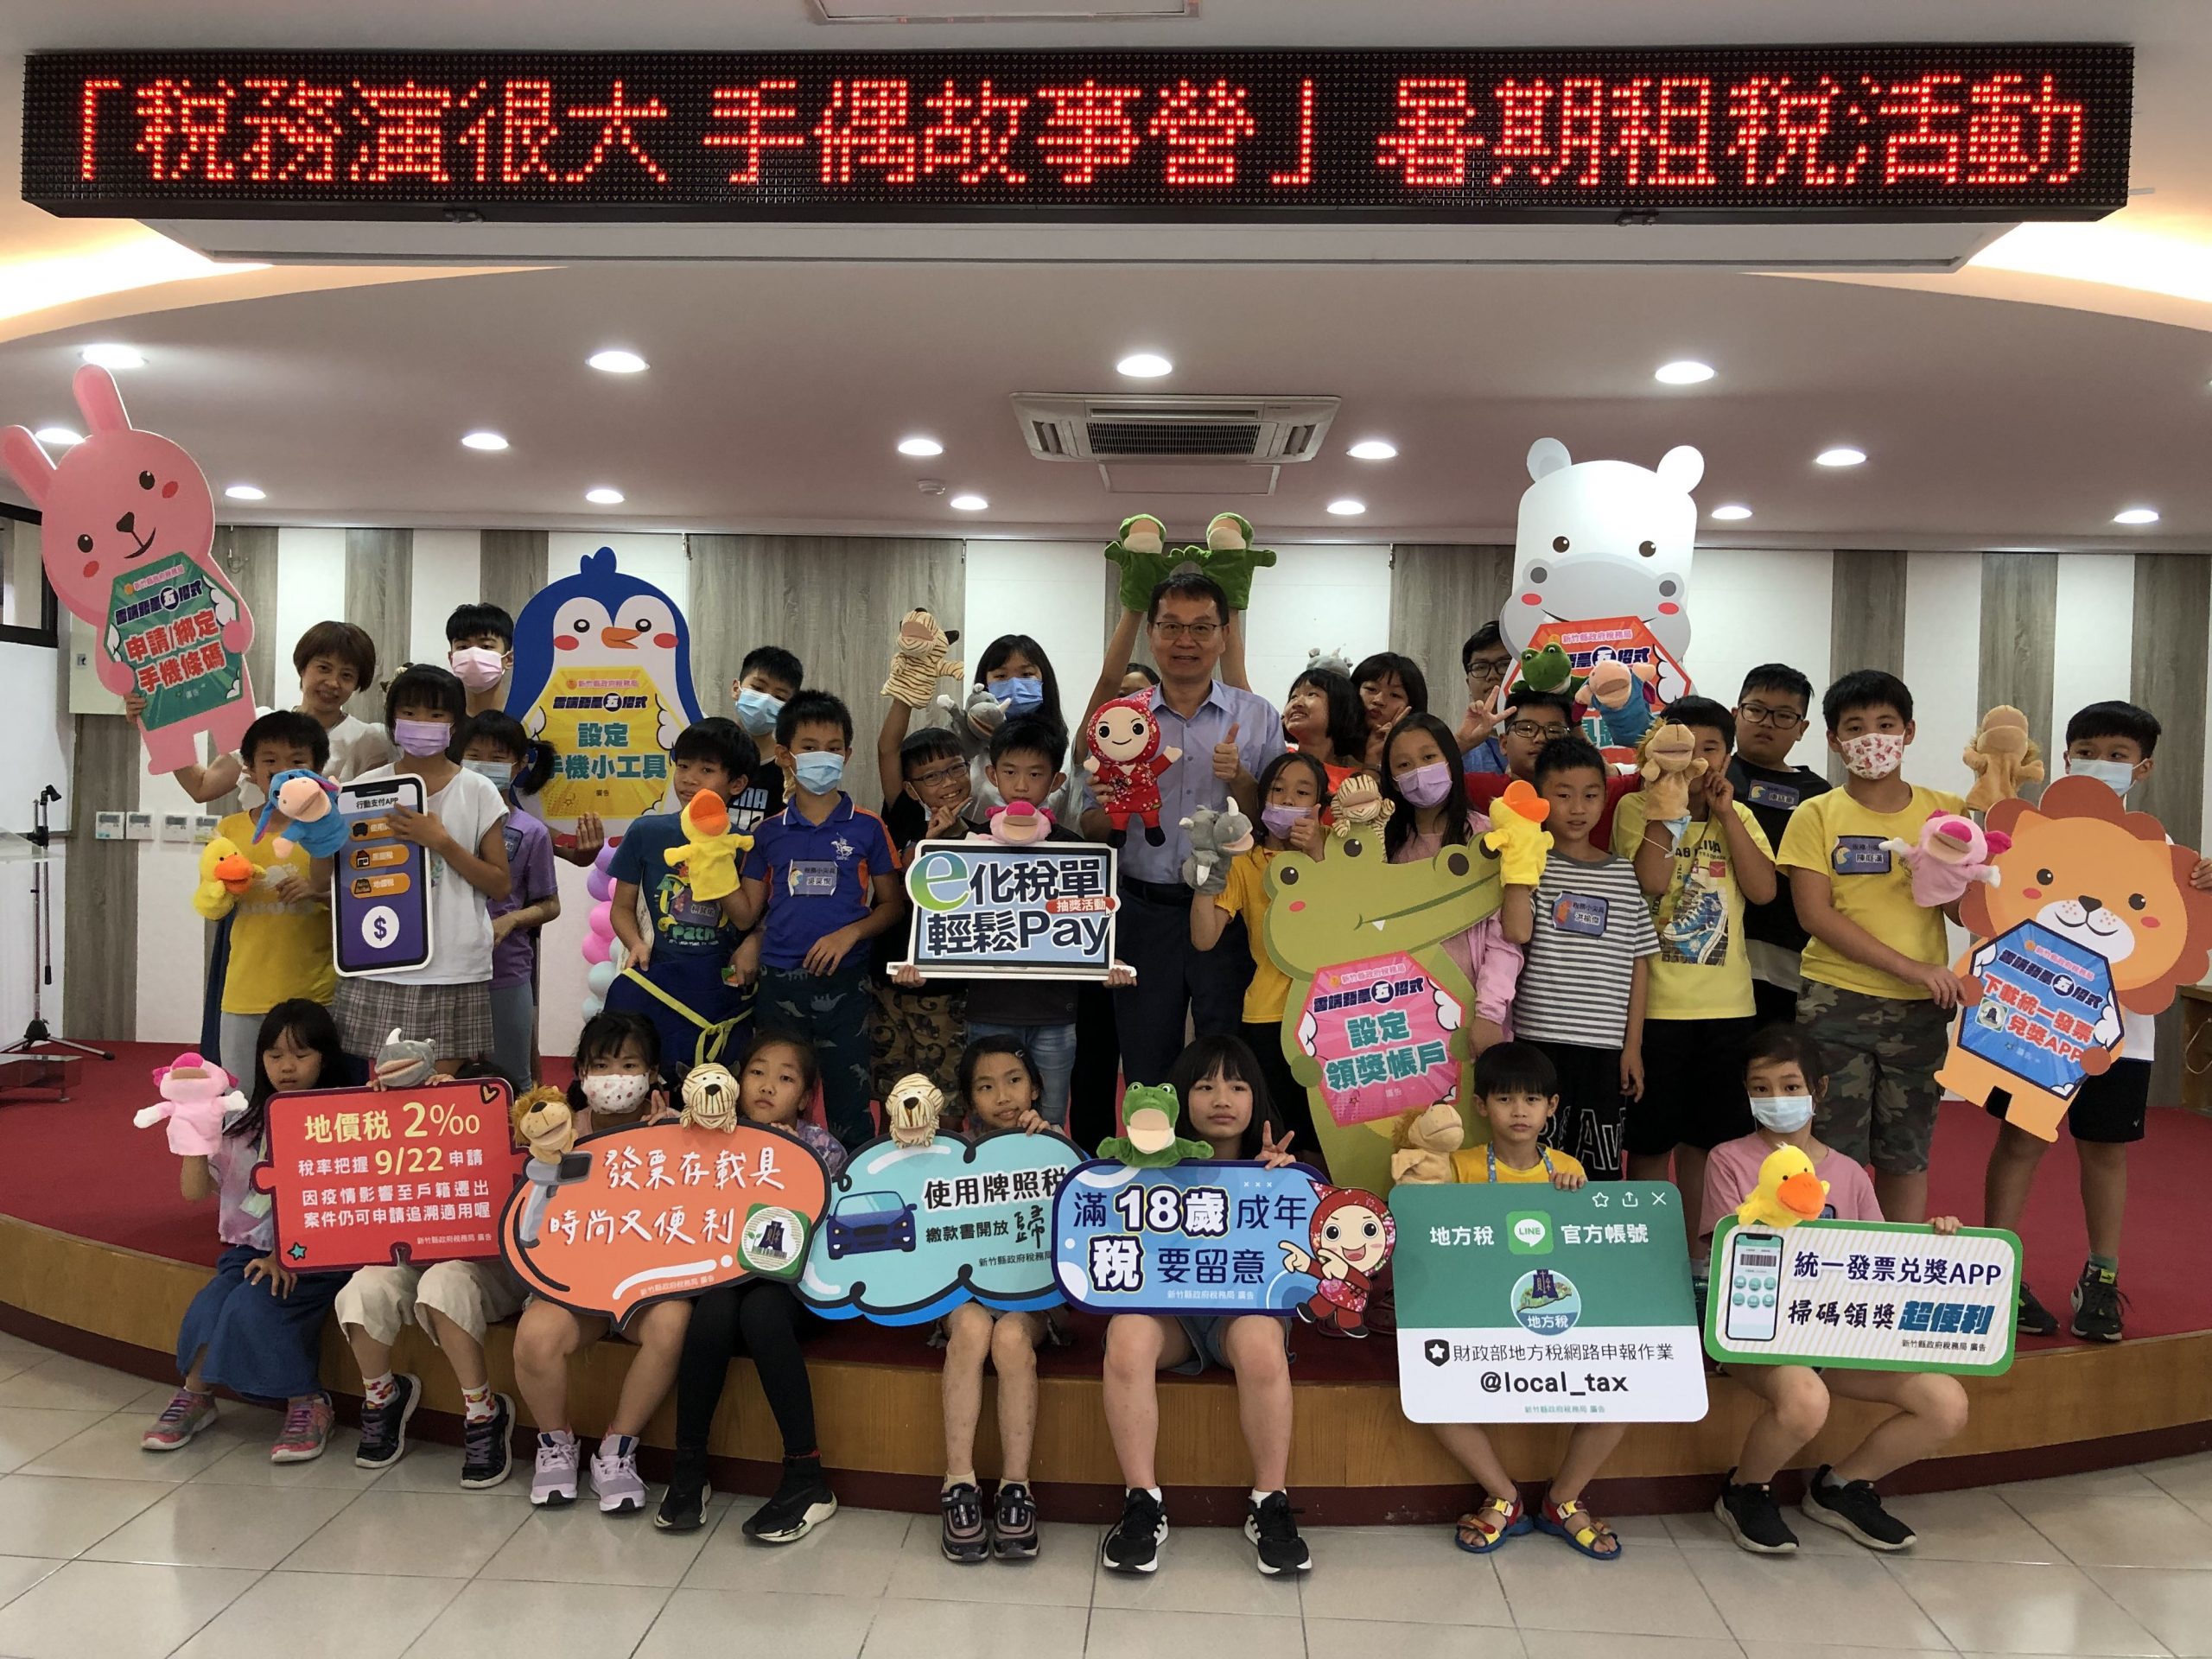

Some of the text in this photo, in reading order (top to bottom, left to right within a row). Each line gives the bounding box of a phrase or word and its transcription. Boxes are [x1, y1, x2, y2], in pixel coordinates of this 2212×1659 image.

[137, 641, 226, 693] 手機條碼
[578, 722, 628, 747] 設定
[1056, 898, 1106, 912] 抽獎活動
[927, 911, 1109, 956] 輕鬆Pay
[1985, 973, 2095, 1043] 下載統一發票
[1346, 1010, 1410, 1049] 設定
[1325, 1040, 1447, 1090] 領獎帳戶
[375, 1147, 443, 1176] 9/22
[449, 1148, 483, 1166] 申請
[604, 1146, 785, 1191] 發票存載具
[549, 1206, 734, 1244] 時尚又便利
[1073, 1192, 1106, 1228] 滿
[1236, 1193, 1307, 1230] 成年
[925, 1219, 1009, 1243] 繳款書開放
[1430, 1224, 1649, 1246] 地方稅 LINE 官方帳號
[1158, 1248, 1265, 1285] 要留意
[1528, 1315, 1569, 1328] 地方稅
[1788, 1300, 1996, 1335] 掃碼領獎 超便利
[1453, 1344, 1674, 1362] 財政部地方稅網路申報作業
[1480, 1371, 1630, 1396] @local_tax
